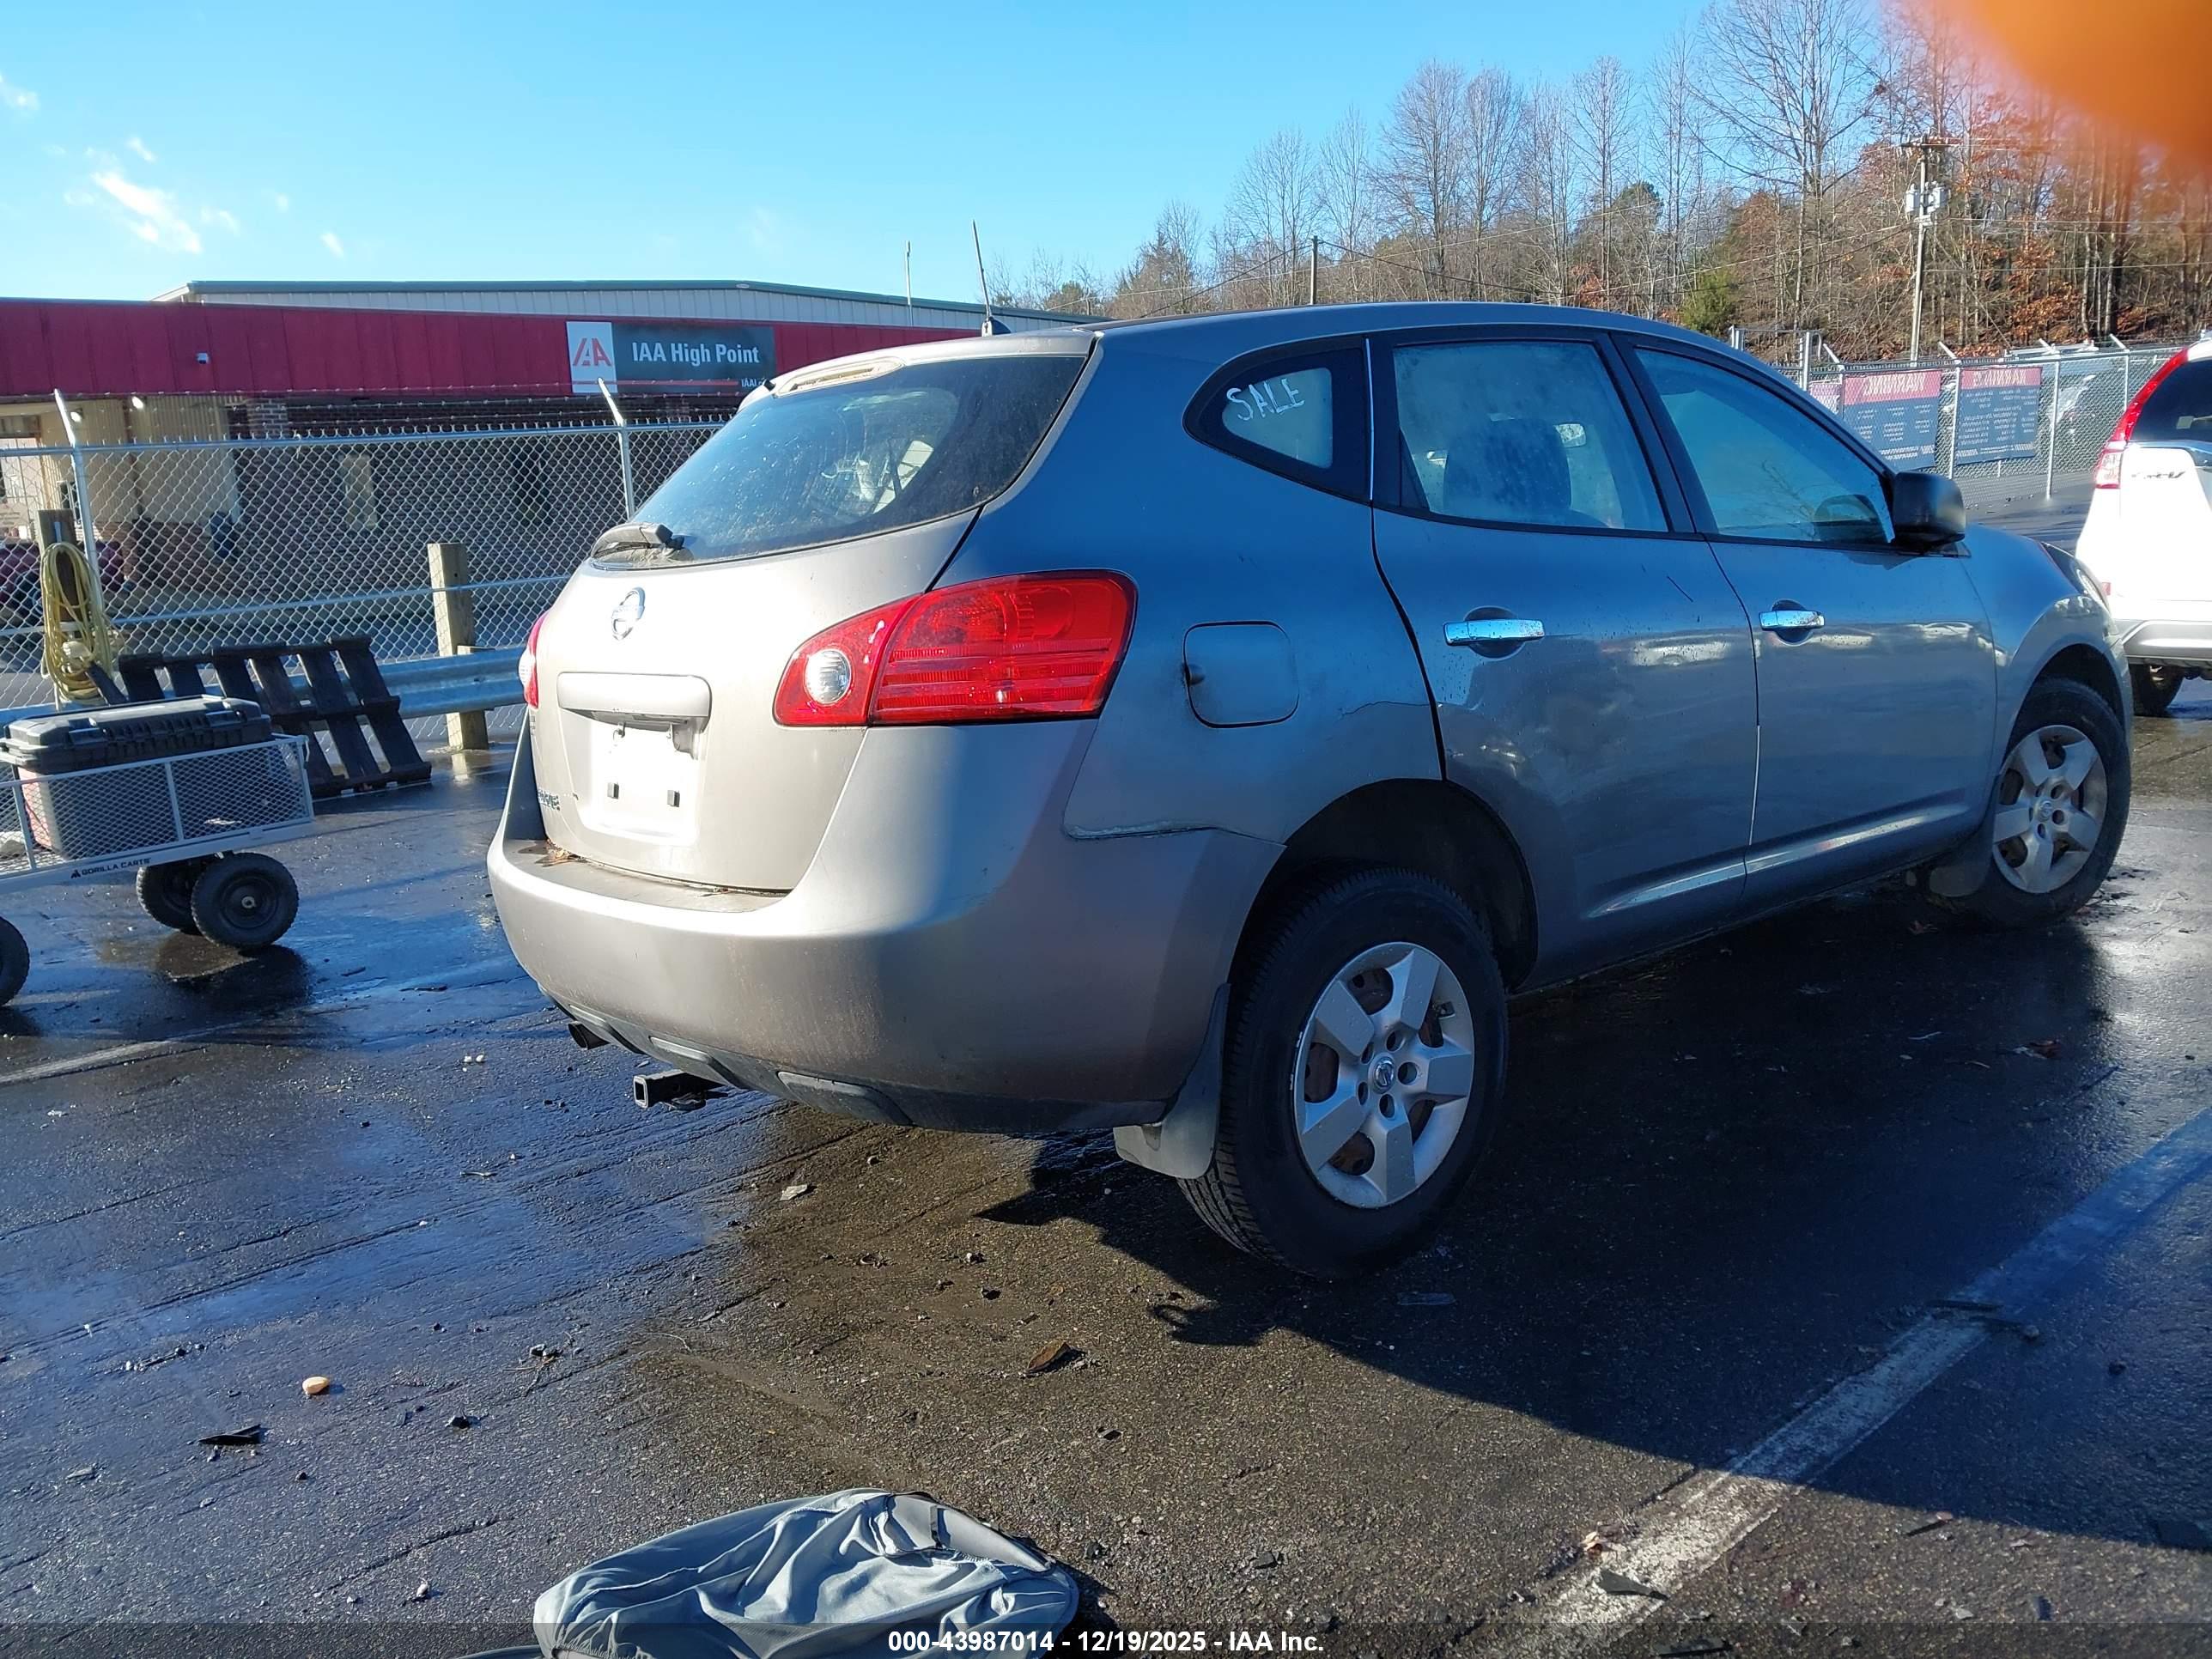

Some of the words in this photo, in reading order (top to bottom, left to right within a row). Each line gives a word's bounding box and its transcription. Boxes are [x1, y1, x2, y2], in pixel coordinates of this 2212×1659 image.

[632, 342, 666, 362] IAA
[672, 343, 711, 367] High
[716, 343, 760, 364] Point
[1226, 378, 1305, 421] SALE
[82, 864, 118, 876] GORILLA
